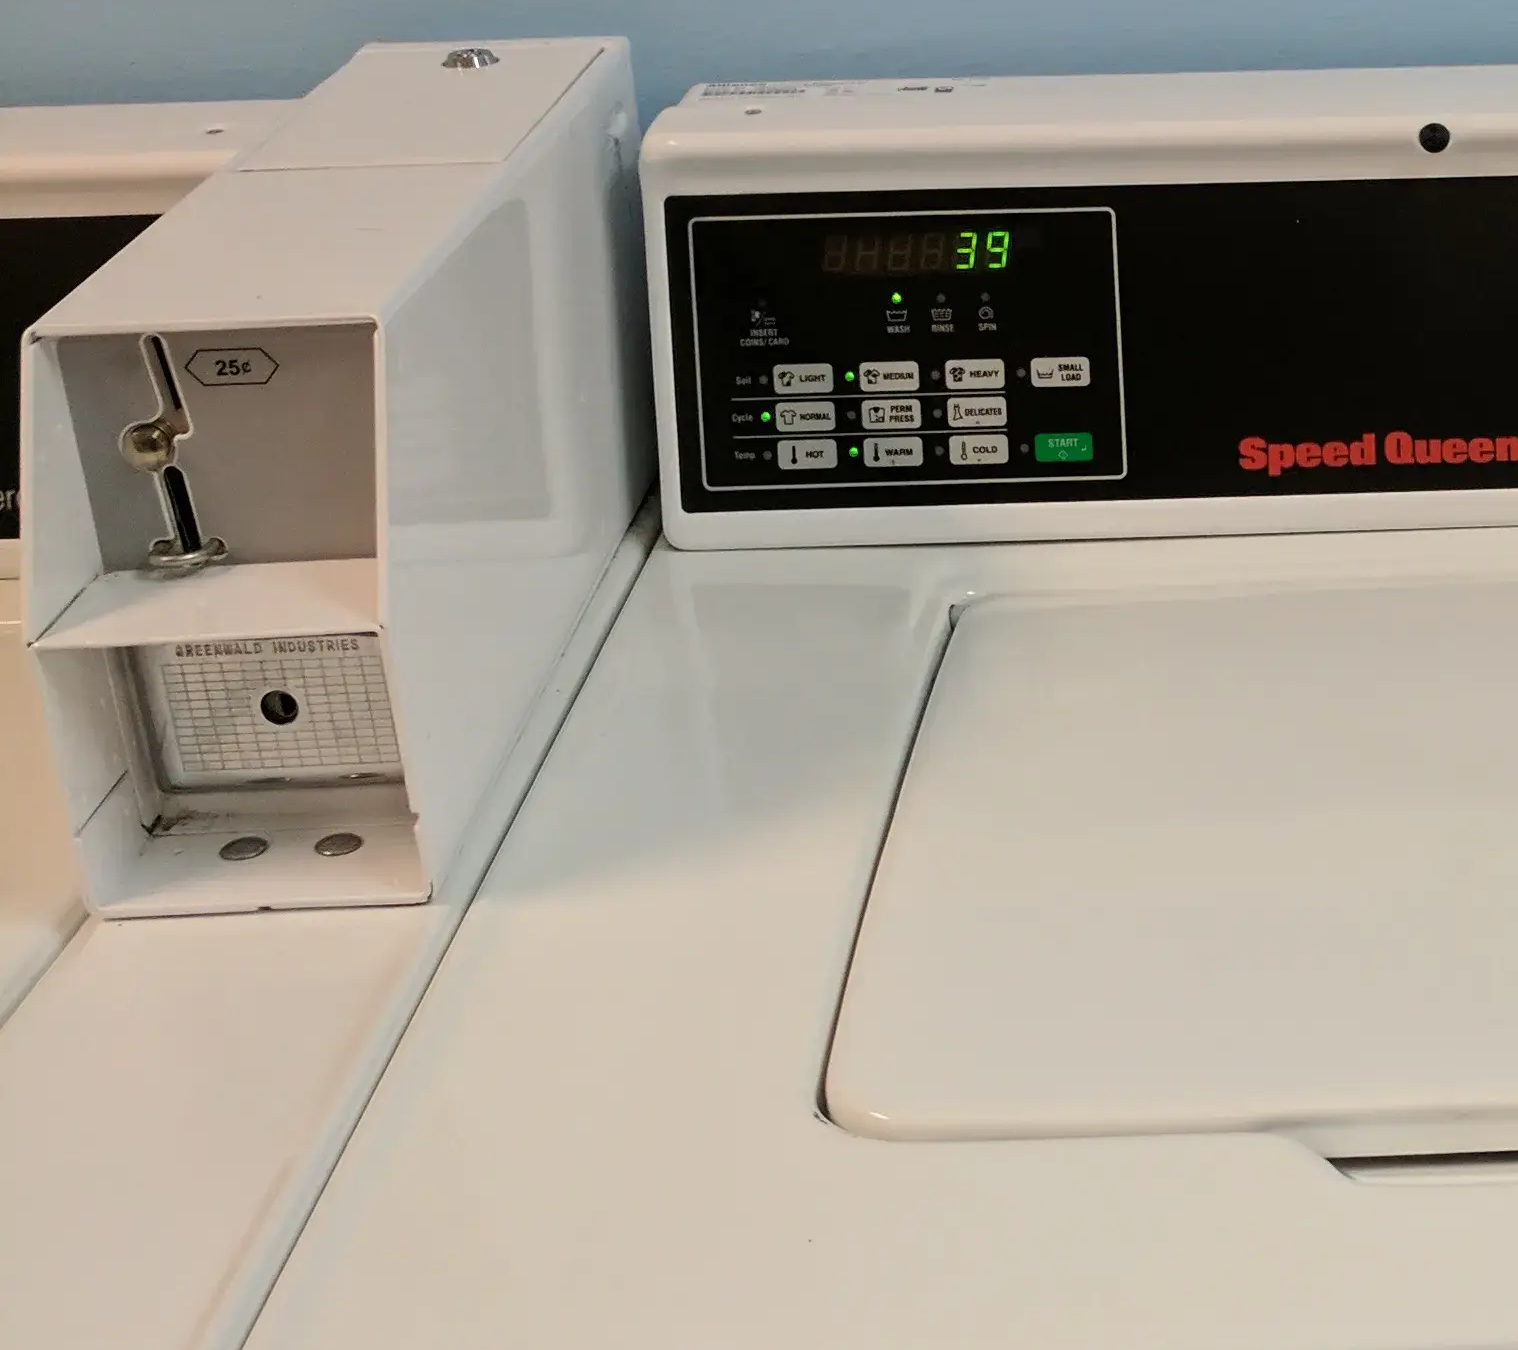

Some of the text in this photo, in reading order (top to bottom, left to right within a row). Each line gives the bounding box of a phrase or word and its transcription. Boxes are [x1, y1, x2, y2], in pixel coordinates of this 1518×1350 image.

[955, 231, 1010, 270] 39
[886, 324, 910, 334] WASH
[931, 323, 954, 333] RINSE
[978, 322, 997, 332] SPIN
[750, 328, 778, 337] INSERT
[215, 359, 252, 376] 25¢
[1058, 363, 1084, 372] SMALL
[883, 372, 914, 381] MEDIUM
[969, 369, 999, 378] HEAVY
[1061, 373, 1082, 382] LOAD
[736, 376, 752, 386] Soil
[800, 374, 827, 383] LIGHT
[890, 405, 913, 413] PERM
[964, 408, 1002, 417] DELICATES
[732, 413, 753, 424] Cycle
[800, 412, 831, 421] NORMAL
[889, 415, 915, 423] PRESS
[1048, 438, 1079, 448] START
[884, 448, 913, 457] WARM
[972, 445, 998, 454] COLD
[805, 450, 825, 459] HOT
[1238, 432, 1377, 477] Speed
[175, 637, 361, 658] GREENWALD INDUSTRIES
